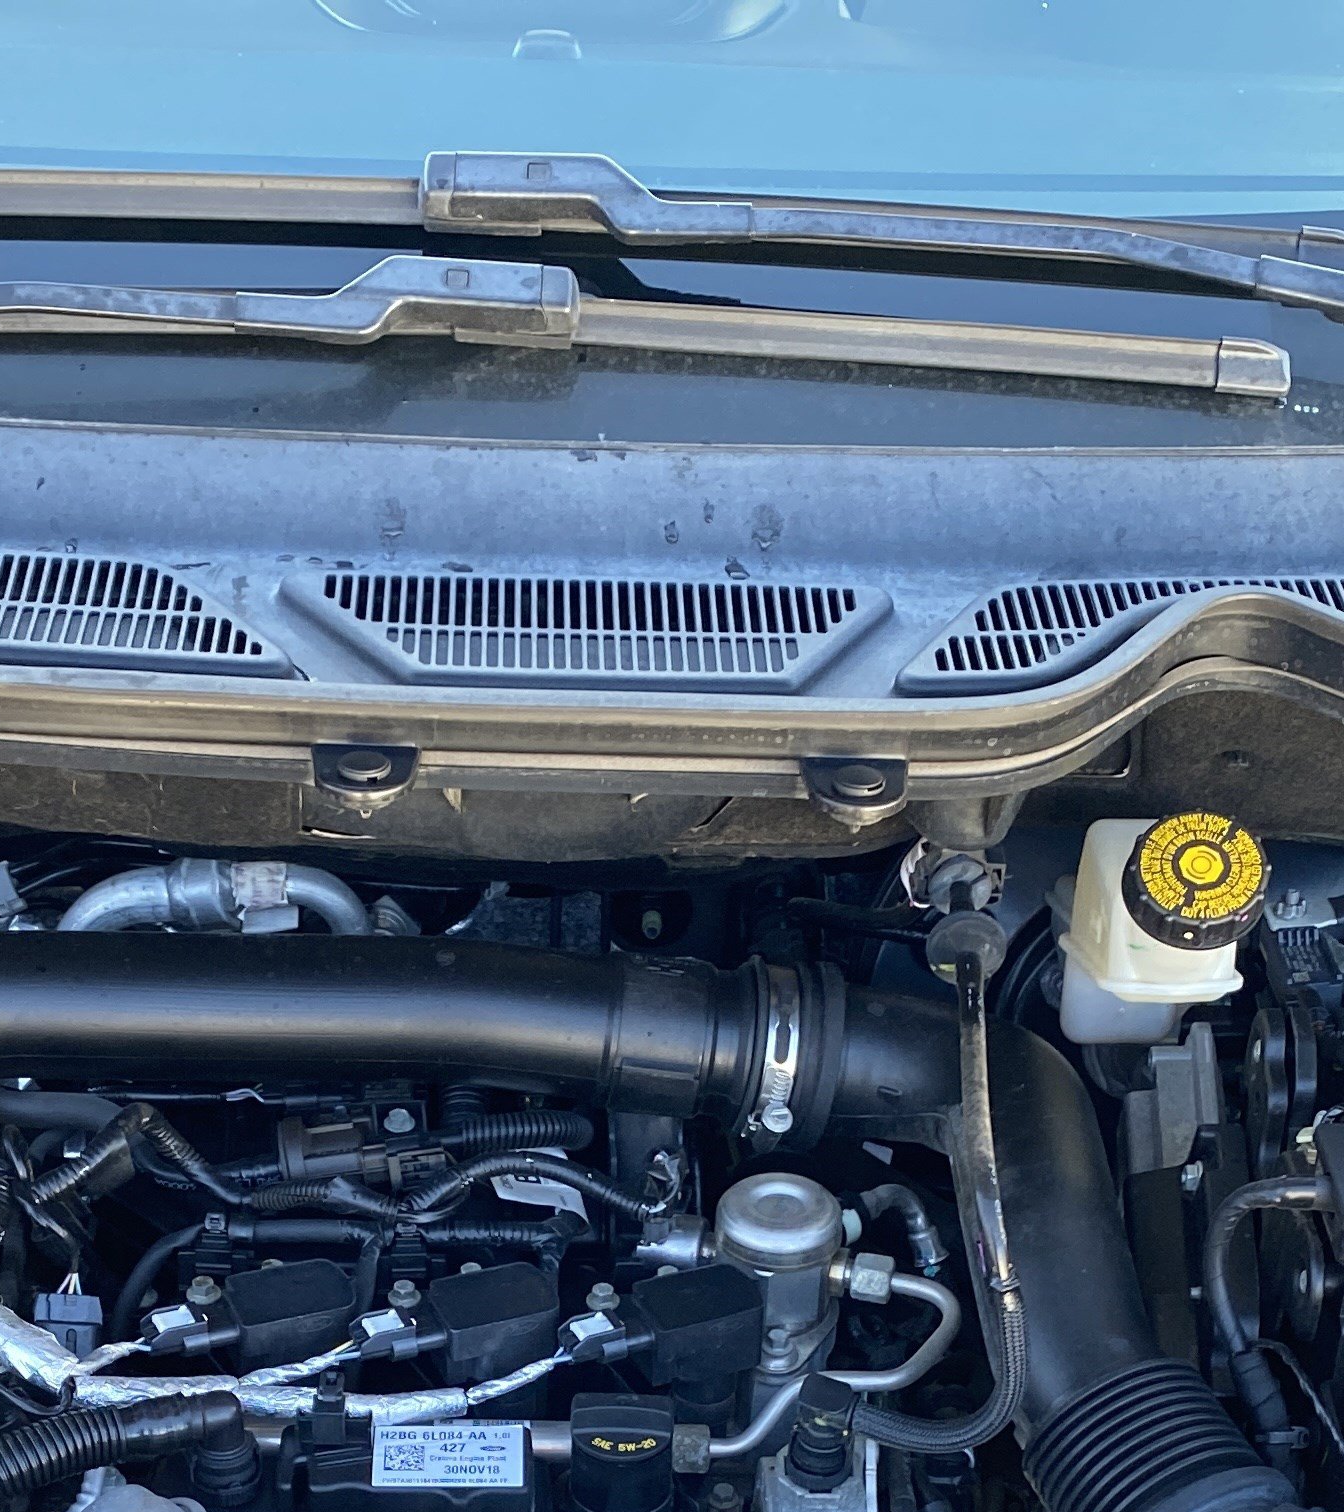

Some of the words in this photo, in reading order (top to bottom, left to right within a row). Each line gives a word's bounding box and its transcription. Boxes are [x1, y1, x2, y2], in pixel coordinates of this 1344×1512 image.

[380, 1430, 417, 1440] H2BG
[422, 1430, 463, 1440] 6L084
[467, 1430, 487, 1440] AA
[439, 1442, 466, 1453] 427
[444, 1464, 500, 1475] 30NOV18
